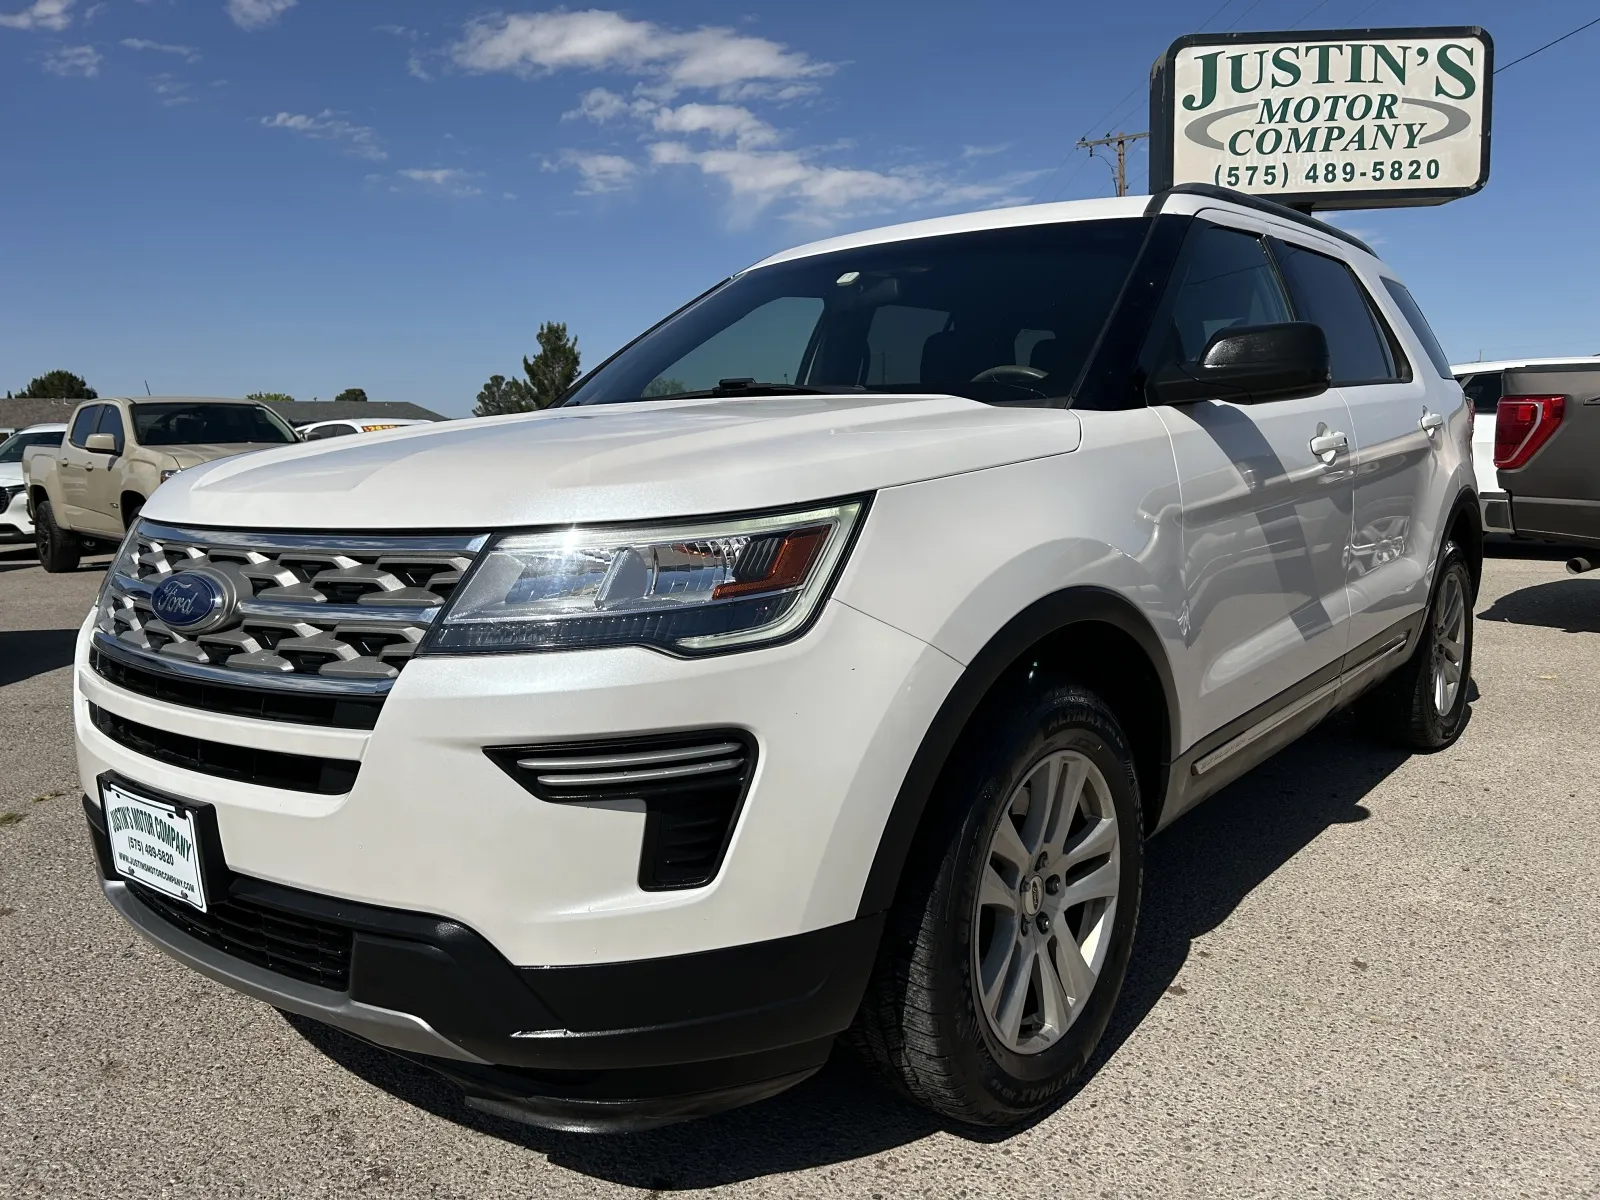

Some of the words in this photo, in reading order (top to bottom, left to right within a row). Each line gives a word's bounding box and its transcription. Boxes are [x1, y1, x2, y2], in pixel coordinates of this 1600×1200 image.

[1182, 43, 1476, 111] JUSTIN'S
[1255, 93, 1399, 125] MOTOR
[1228, 122, 1428, 156] COMPANY
[1214, 162, 1289, 188] (575)
[1304, 159, 1440, 183] 489-5820
[157, 580, 199, 615] Ford
[131, 806, 155, 837] MOTOR
[154, 816, 191, 862] COMPANY
[144, 843, 174, 866] 489-5820
